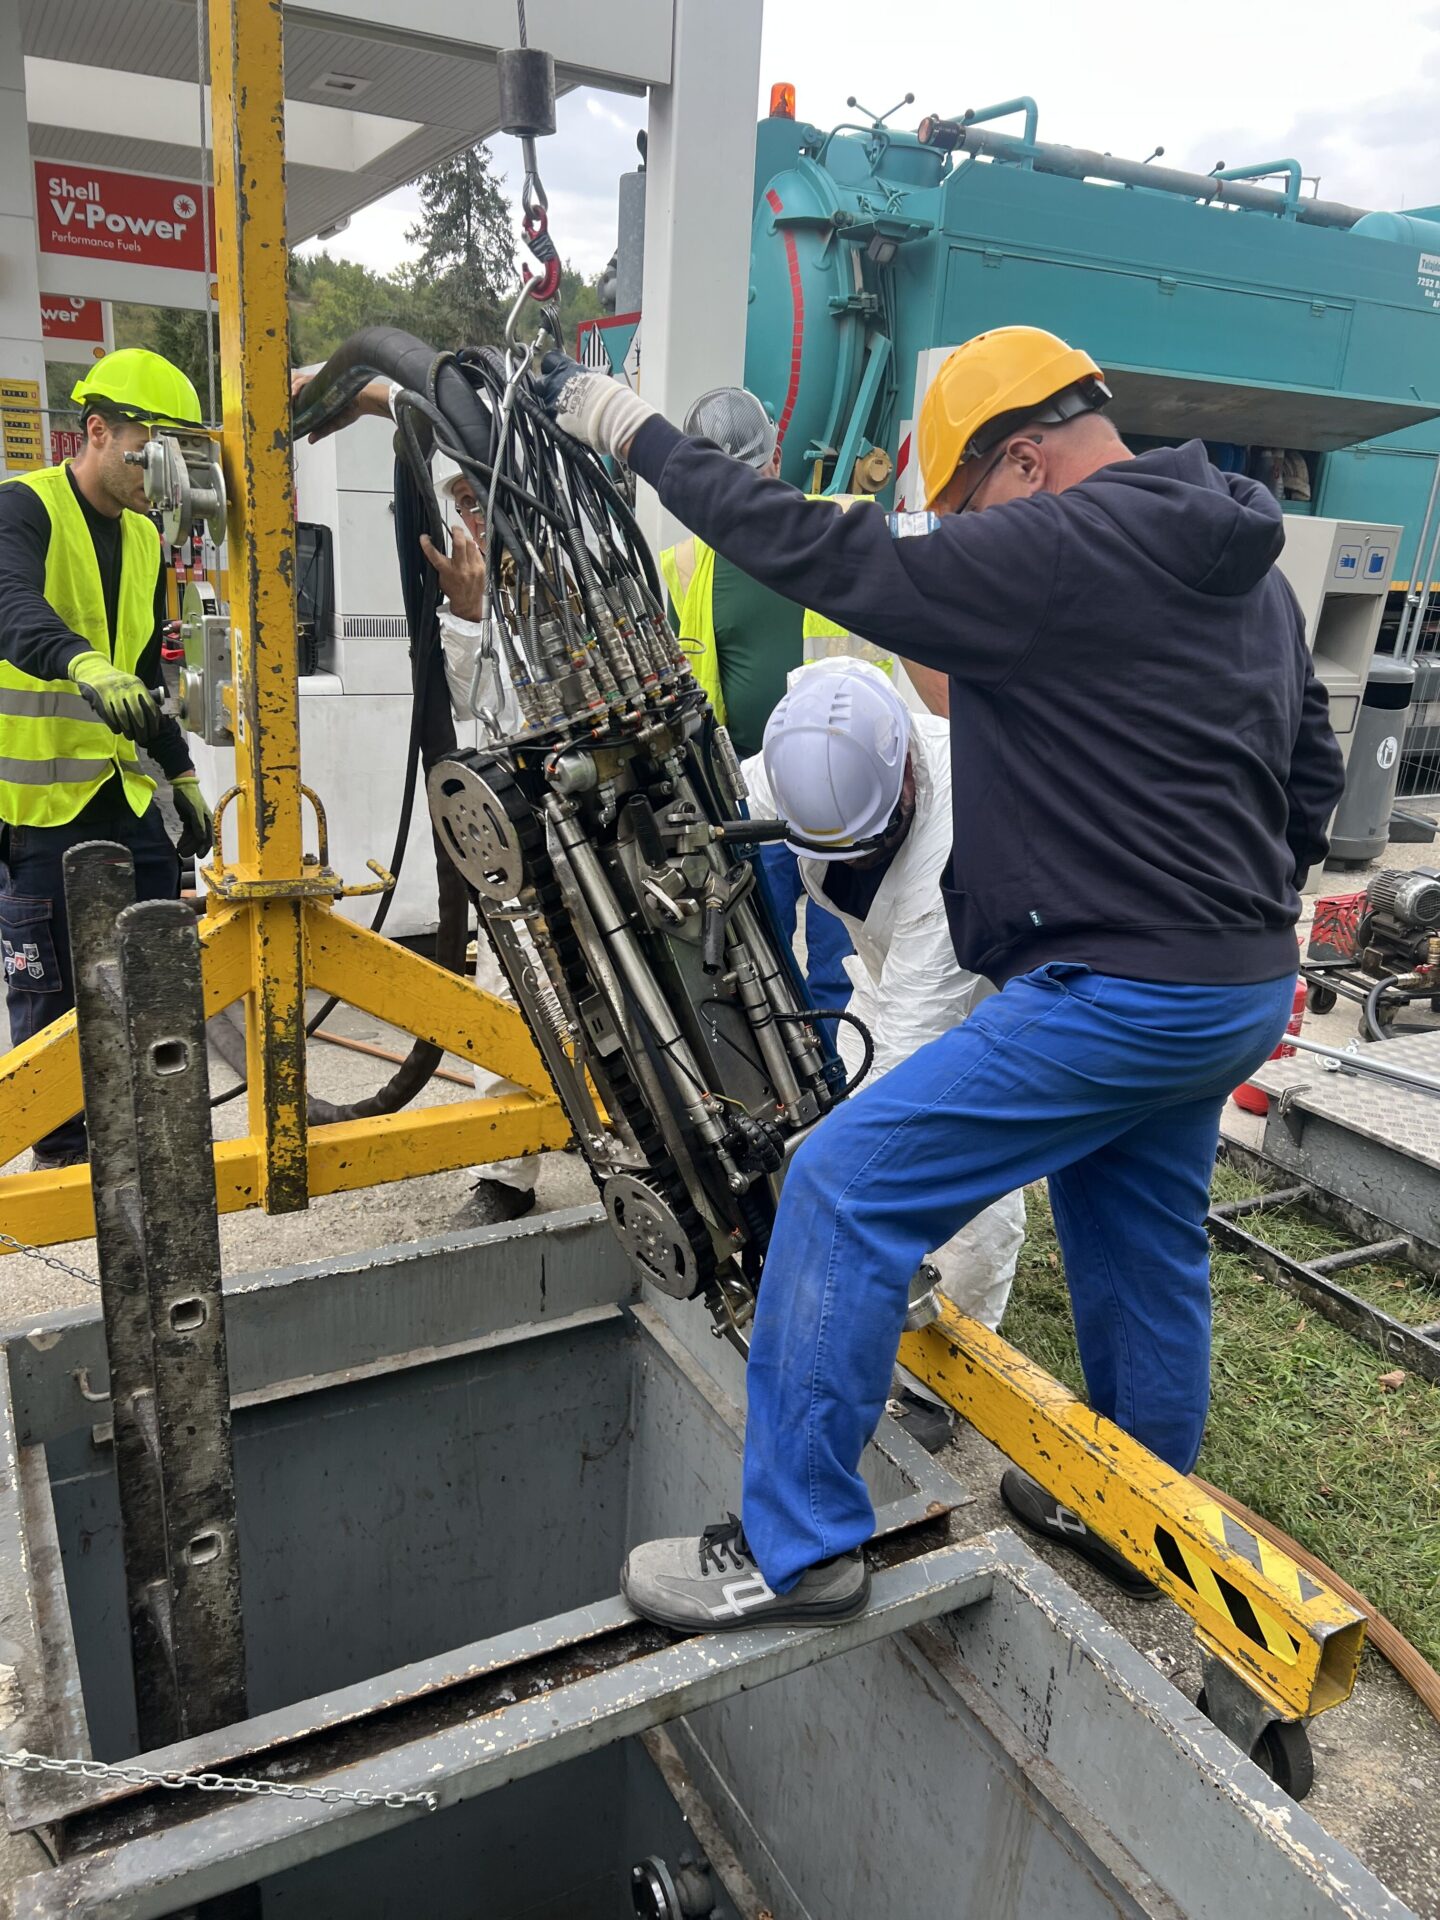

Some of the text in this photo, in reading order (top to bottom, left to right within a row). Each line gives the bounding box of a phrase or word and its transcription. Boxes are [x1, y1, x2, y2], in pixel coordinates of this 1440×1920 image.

[48, 177, 100, 202] Shell
[50, 198, 187, 241] V-Power
[51, 230, 142, 252] Performance Fuels
